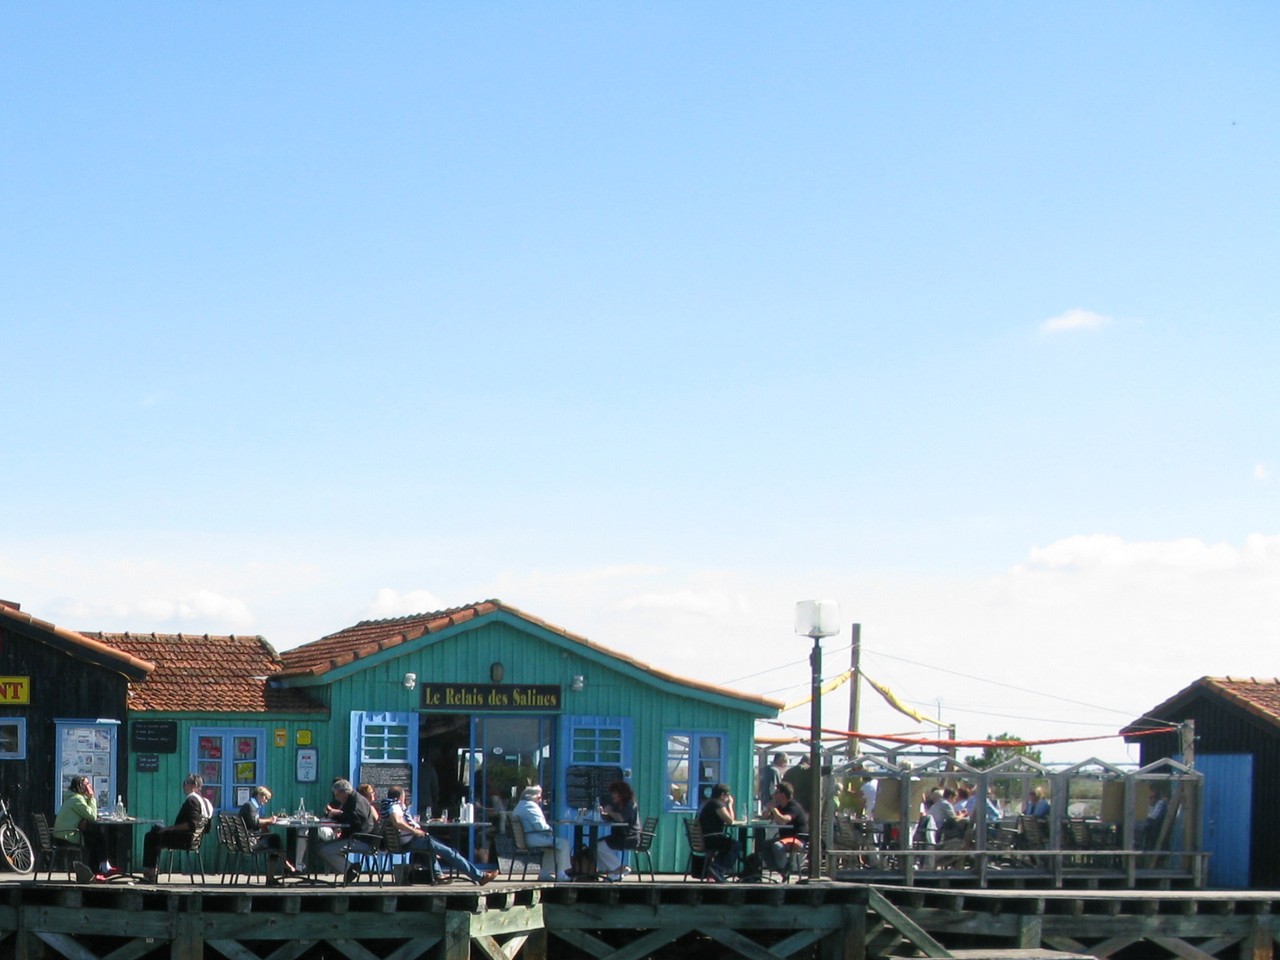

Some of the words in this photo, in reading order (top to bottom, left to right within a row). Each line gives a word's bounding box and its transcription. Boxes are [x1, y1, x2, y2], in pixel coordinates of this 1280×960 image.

[425, 687, 440, 705] Le
[445, 687, 484, 706] Relais
[488, 688, 509, 706] des
[513, 688, 557, 707] Salines
